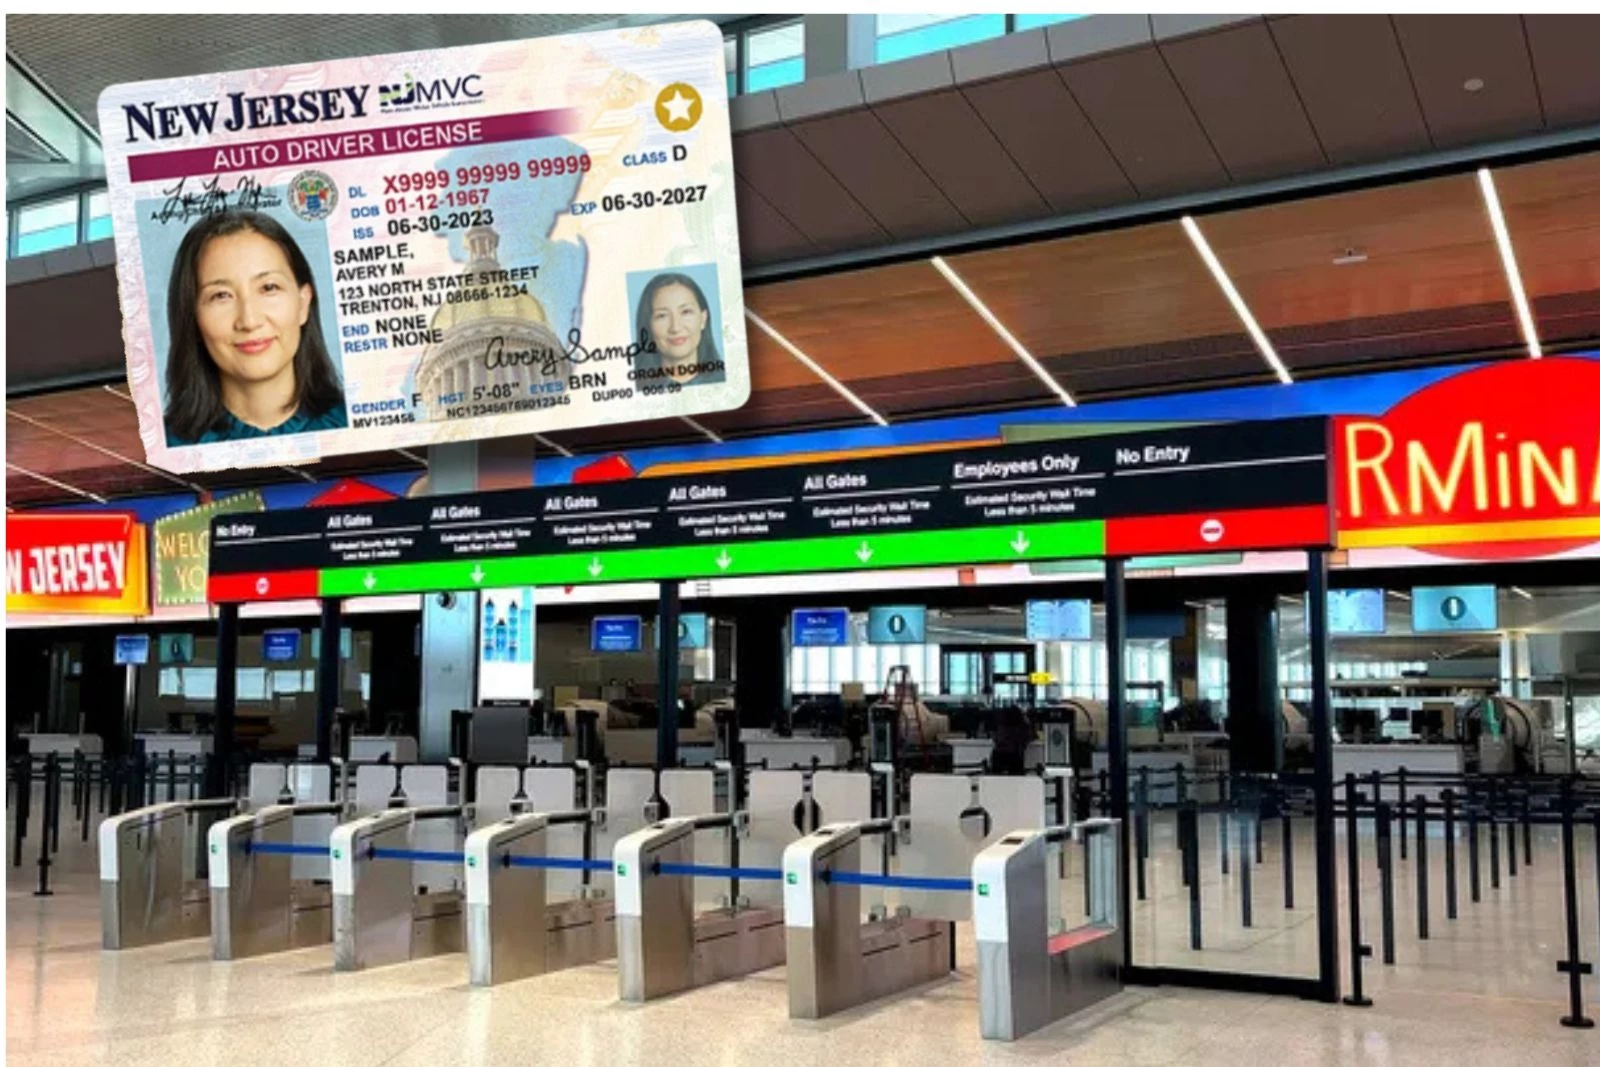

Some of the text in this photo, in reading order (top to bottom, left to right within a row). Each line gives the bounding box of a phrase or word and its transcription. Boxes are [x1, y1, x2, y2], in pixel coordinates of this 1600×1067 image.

[122, 84, 371, 142] NEW JERSEY
[213, 120, 484, 170] AUTO DRIVER LICENSE
[622, 145, 687, 167] CLASS D
[349, 186, 367, 199] DL
[383, 170, 451, 195] X9999
[455, 162, 520, 187] 99999
[527, 154, 593, 177] 99999
[350, 188, 490, 219] DOB 01-12-1967
[569, 185, 708, 216] EXP 06-30-2027
[353, 209, 494, 240] ISS 06-30-2023
[333, 243, 415, 265] SAMPLE,
[336, 263, 405, 281] AVERY M
[339, 265, 539, 300] 123 NORTH STATE STREET
[340, 296, 419, 317] TRENTON,
[423, 294, 442, 306] NJ
[342, 314, 428, 338] END NONE
[344, 328, 444, 354] RESTR NONE
[559, 328, 658, 366] Sample
[627, 360, 726, 381] ORGAN DONOR
[352, 399, 405, 414] GENDER
[412, 393, 422, 408] F
[438, 392, 465, 405] HGT
[529, 381, 564, 395] EYES
[569, 372, 606, 390] BRN
[954, 453, 1080, 479] Employees Only
[1116, 445, 1191, 465] No Entry
[668, 485, 727, 501] All Gates
[804, 473, 867, 491] All Gates
[431, 504, 481, 520] All Gates
[545, 495, 598, 511] All Gates
[231, 524, 256, 538] Entry
[327, 514, 373, 529] All Gates
[28, 540, 126, 595] JERSEY
